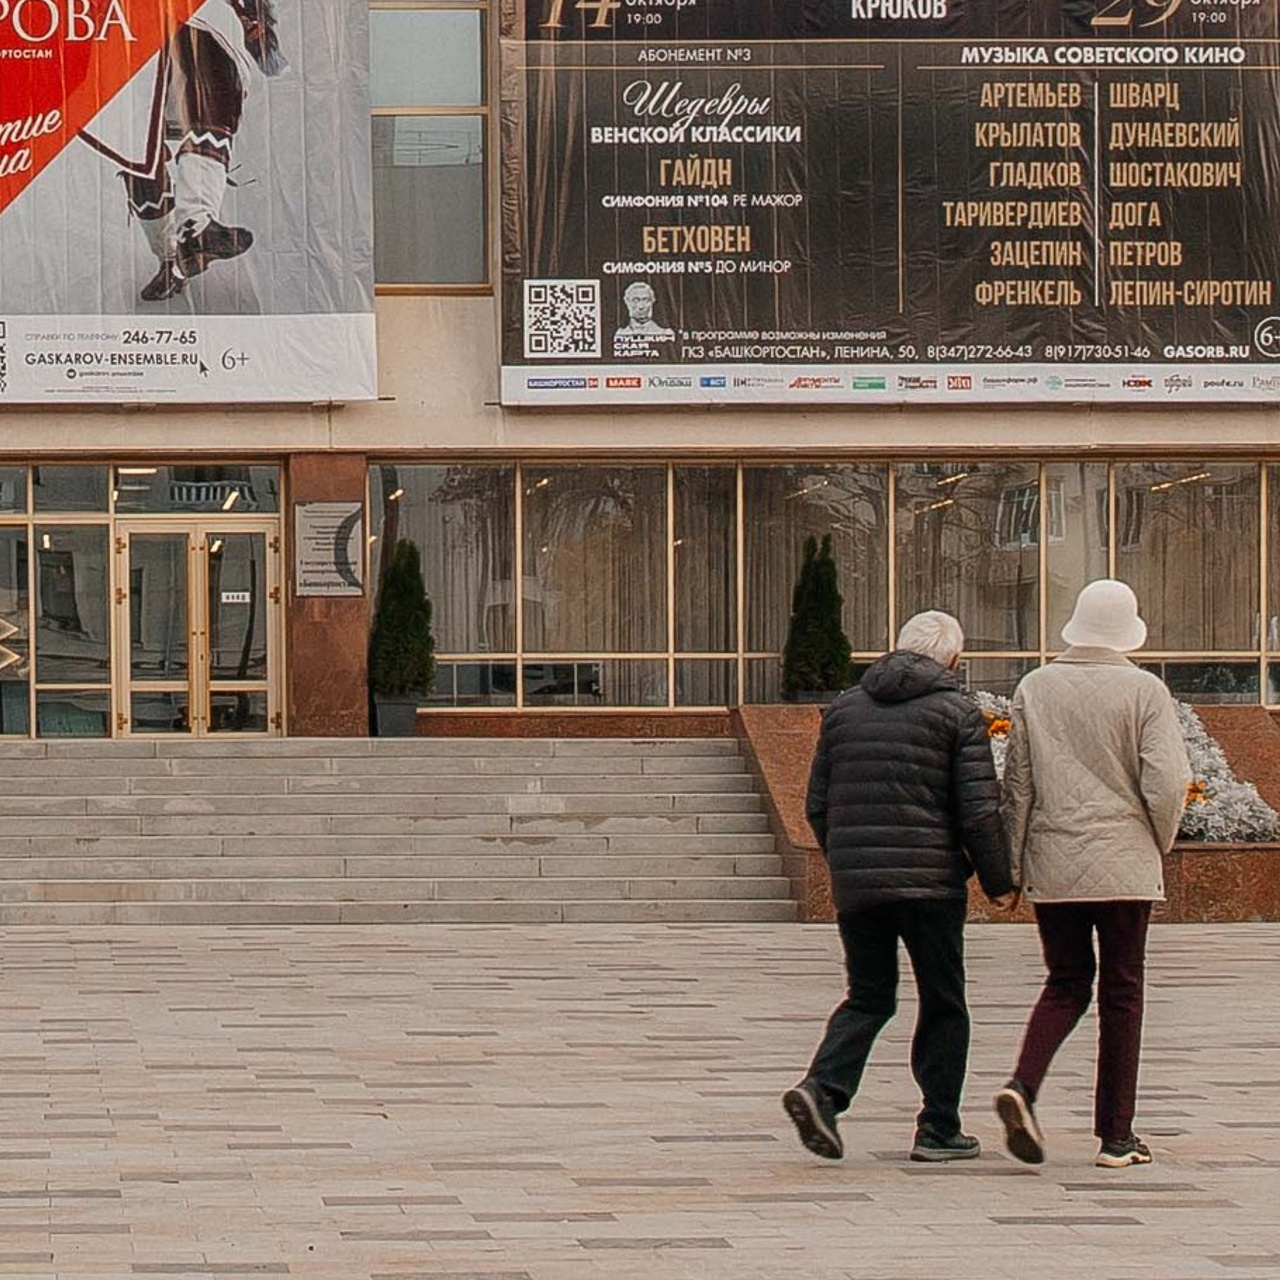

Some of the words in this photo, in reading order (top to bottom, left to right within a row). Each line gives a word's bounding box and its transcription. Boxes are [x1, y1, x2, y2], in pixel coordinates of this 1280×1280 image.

[626, 12, 663, 25] 19:00
[1191, 11, 1227, 24] 19:00
[638, 48, 722, 62] АБОНЕМЕНТ
[726, 47, 752, 62] №3
[961, 46, 1049, 64] МУЗЫКА
[1054, 46, 1179, 64] СОВЕТСКОГО
[1184, 46, 1246, 64] КИНО
[622, 79, 772, 131] Шедевры
[980, 82, 1082, 108] АРТЕМЬЕВ
[1109, 82, 1180, 111] ШВАРЦ
[590, 122, 685, 144] ВЕНСКОЙ
[691, 125, 802, 143] КЛАССИКИ
[975, 122, 1082, 148] КРЫЛАТОВ
[1109, 117, 1241, 151] ДУНАЕВСКИЙ
[659, 153, 733, 189] ГАЙДН
[989, 161, 1082, 190] ГЛАДКОВ
[1109, 161, 1242, 187] ШОСТАКОВИЧ
[601, 195, 684, 208] СИМФОНИЯ
[687, 194, 729, 207] №104
[732, 194, 748, 207] РЕ
[751, 193, 803, 207] МАЖОР
[942, 201, 1082, 229] ТАРИВЕРДИЕВ
[1109, 201, 1162, 230] ДОГА
[642, 225, 752, 254] БЕТХОВЕН
[602, 261, 685, 274] СИМФОНИЯ
[687, 261, 713, 274] №5
[715, 260, 736, 274] ДО
[739, 260, 792, 273] МИНОР
[989, 241, 1082, 269] ЗАЦЕПИН
[1109, 241, 1183, 267] ПЕТРОВ
[974, 279, 1082, 306] ФРЕНКЕЛЬ
[1109, 280, 1272, 306] ЛЕПИН-СИРОТИН
[63, 333, 76, 341] ПО
[122, 330, 198, 345] 246-77-65
[690, 331, 759, 343] программе
[761, 331, 821, 341] возможны
[822, 331, 887, 341] изменения
[24, 352, 199, 366] GASKAROV-ENSEMBLE.RU
[221, 347, 250, 370] 6+
[681, 345, 705, 359] ГКЗ
[707, 344, 830, 360] «БАШКОРТОСТАН»,
[833, 344, 894, 360] ЛЕНИНА,
[897, 344, 919, 360] 50,
[926, 344, 1033, 361] 8(347)272-66-43
[1044, 344, 1151, 360] 8(917)730-51-46
[1163, 344, 1250, 359] GASORB.RU
